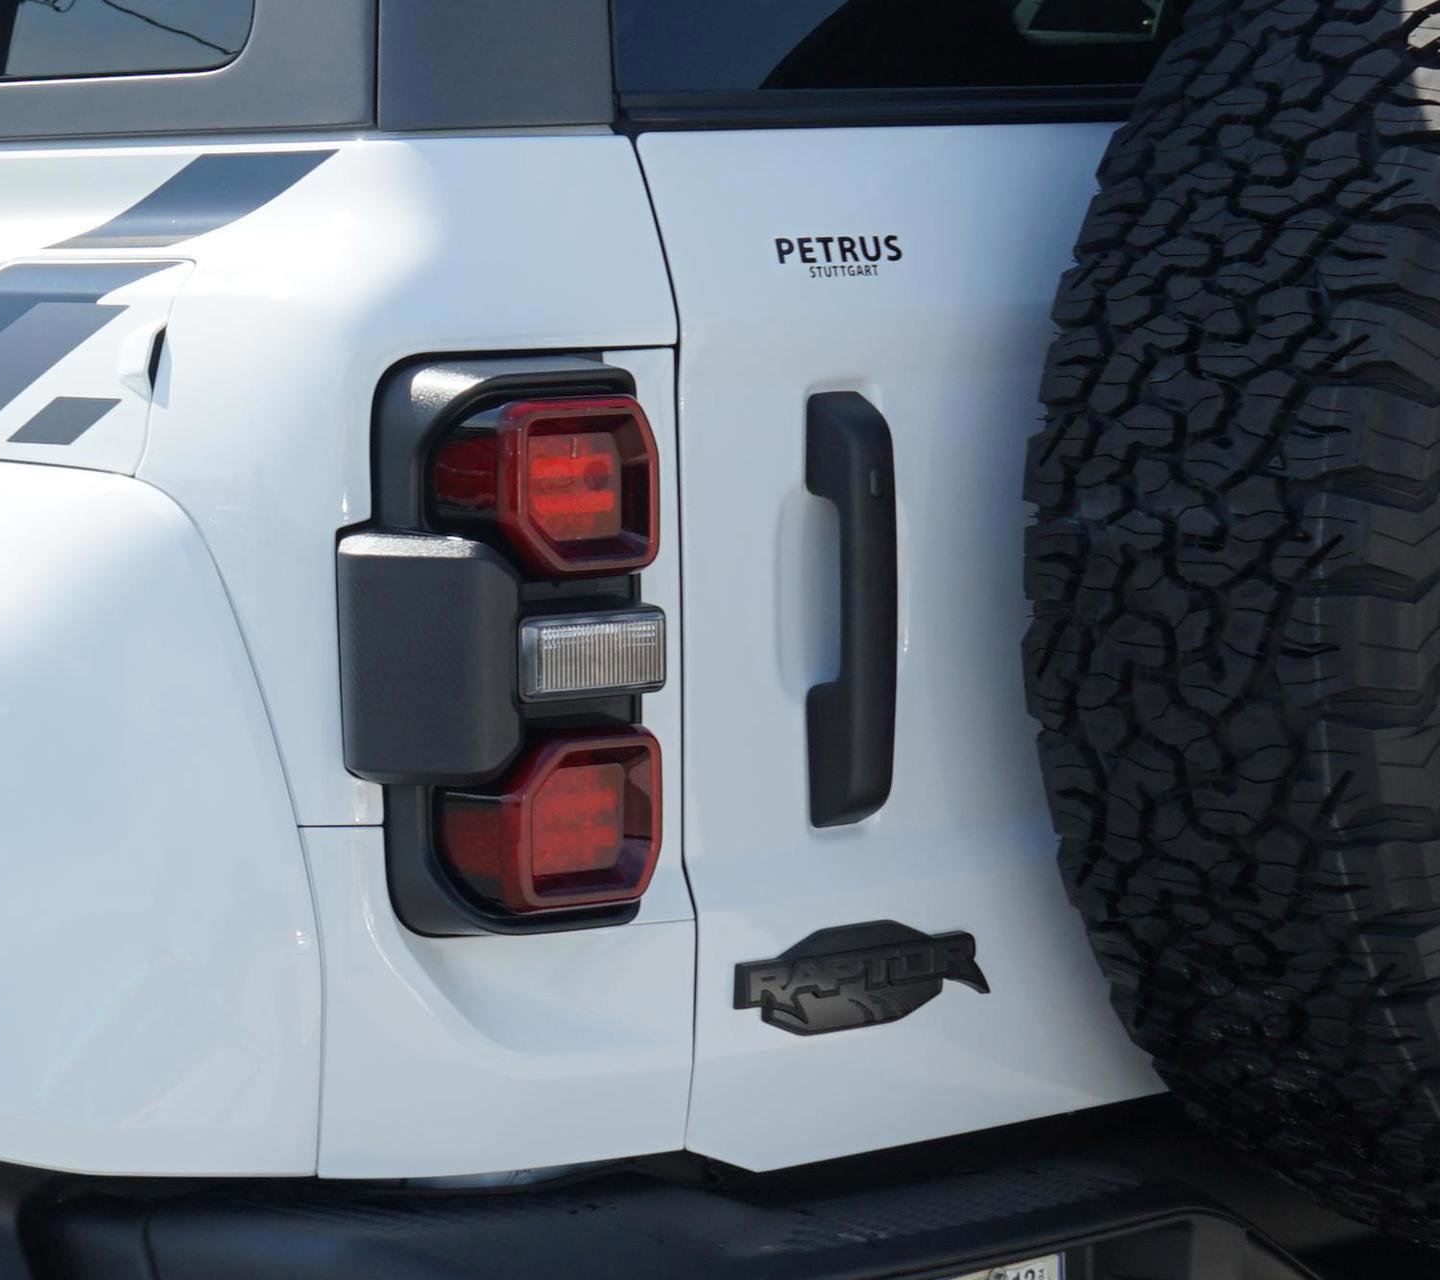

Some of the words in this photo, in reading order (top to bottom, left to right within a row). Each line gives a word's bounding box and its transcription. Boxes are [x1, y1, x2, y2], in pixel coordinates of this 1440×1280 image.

[774, 234, 903, 265] PETRUS
[808, 264, 880, 279] STUTTGART
[742, 931, 991, 1024] RAPTOR
